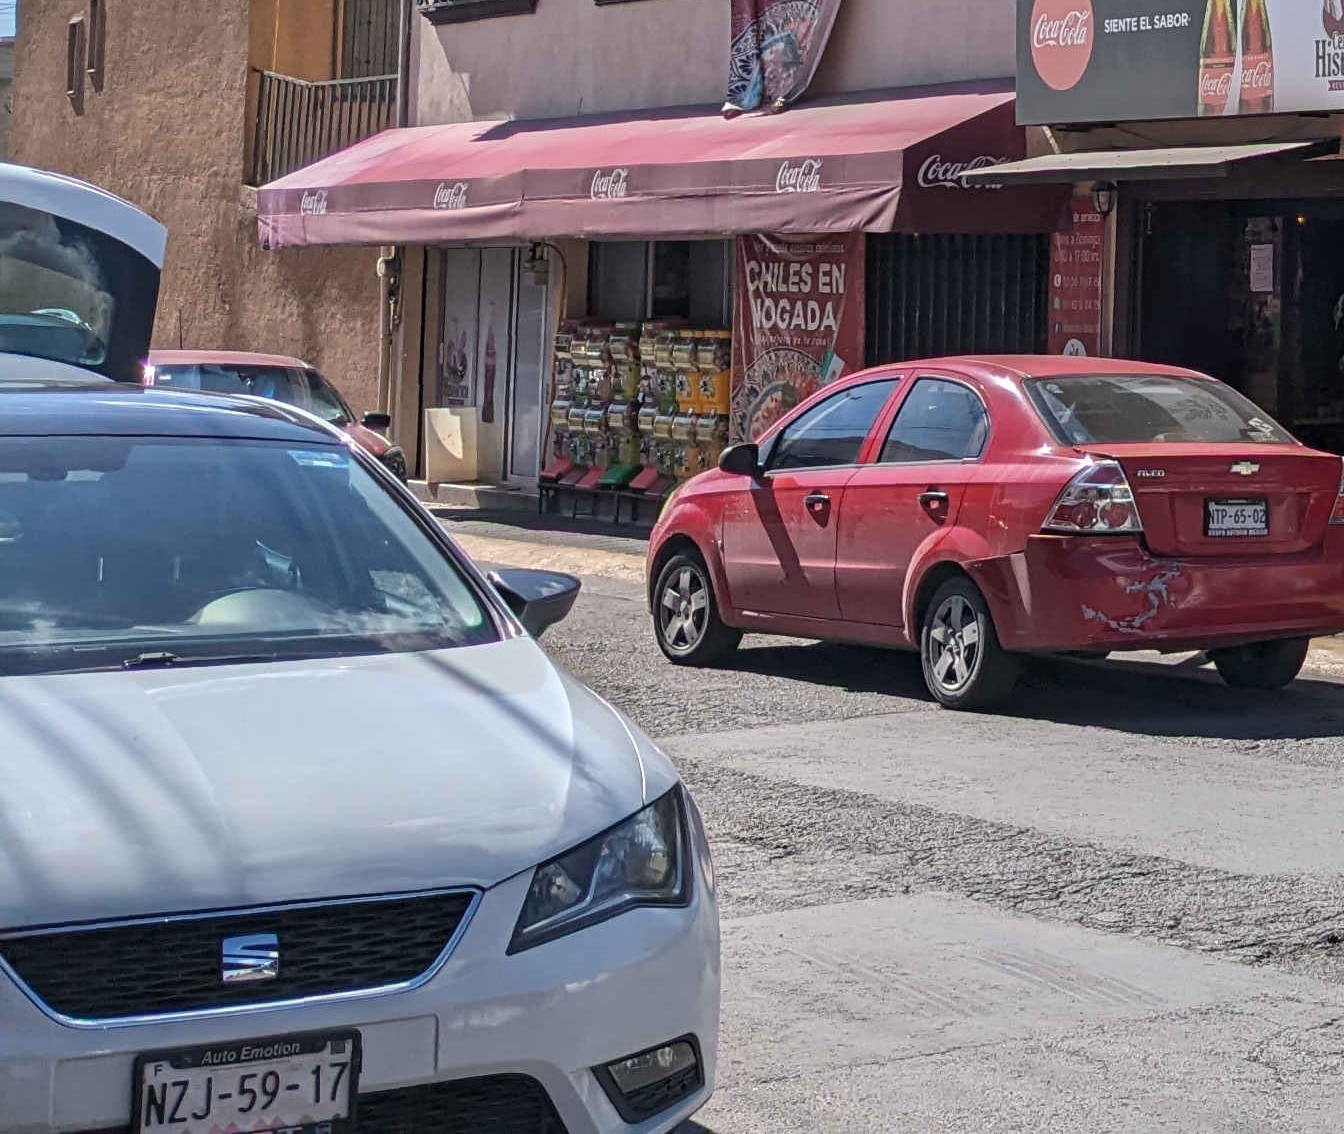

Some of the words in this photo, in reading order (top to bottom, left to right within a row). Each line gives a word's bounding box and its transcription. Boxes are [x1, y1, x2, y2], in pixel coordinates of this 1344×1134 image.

[1104, 16, 1137, 33] SIENTE
[1139, 16, 1152, 30] EL
[1153, 12, 1189, 29] SABOR
[745, 260, 813, 293] CHILES
[818, 262, 845, 294] EN
[752, 298, 837, 331] NOGADA
[201, 1050, 237, 1065] Auto
[240, 1042, 301, 1061] Emotion
[145, 1062, 349, 1126] NZJ-59-17
